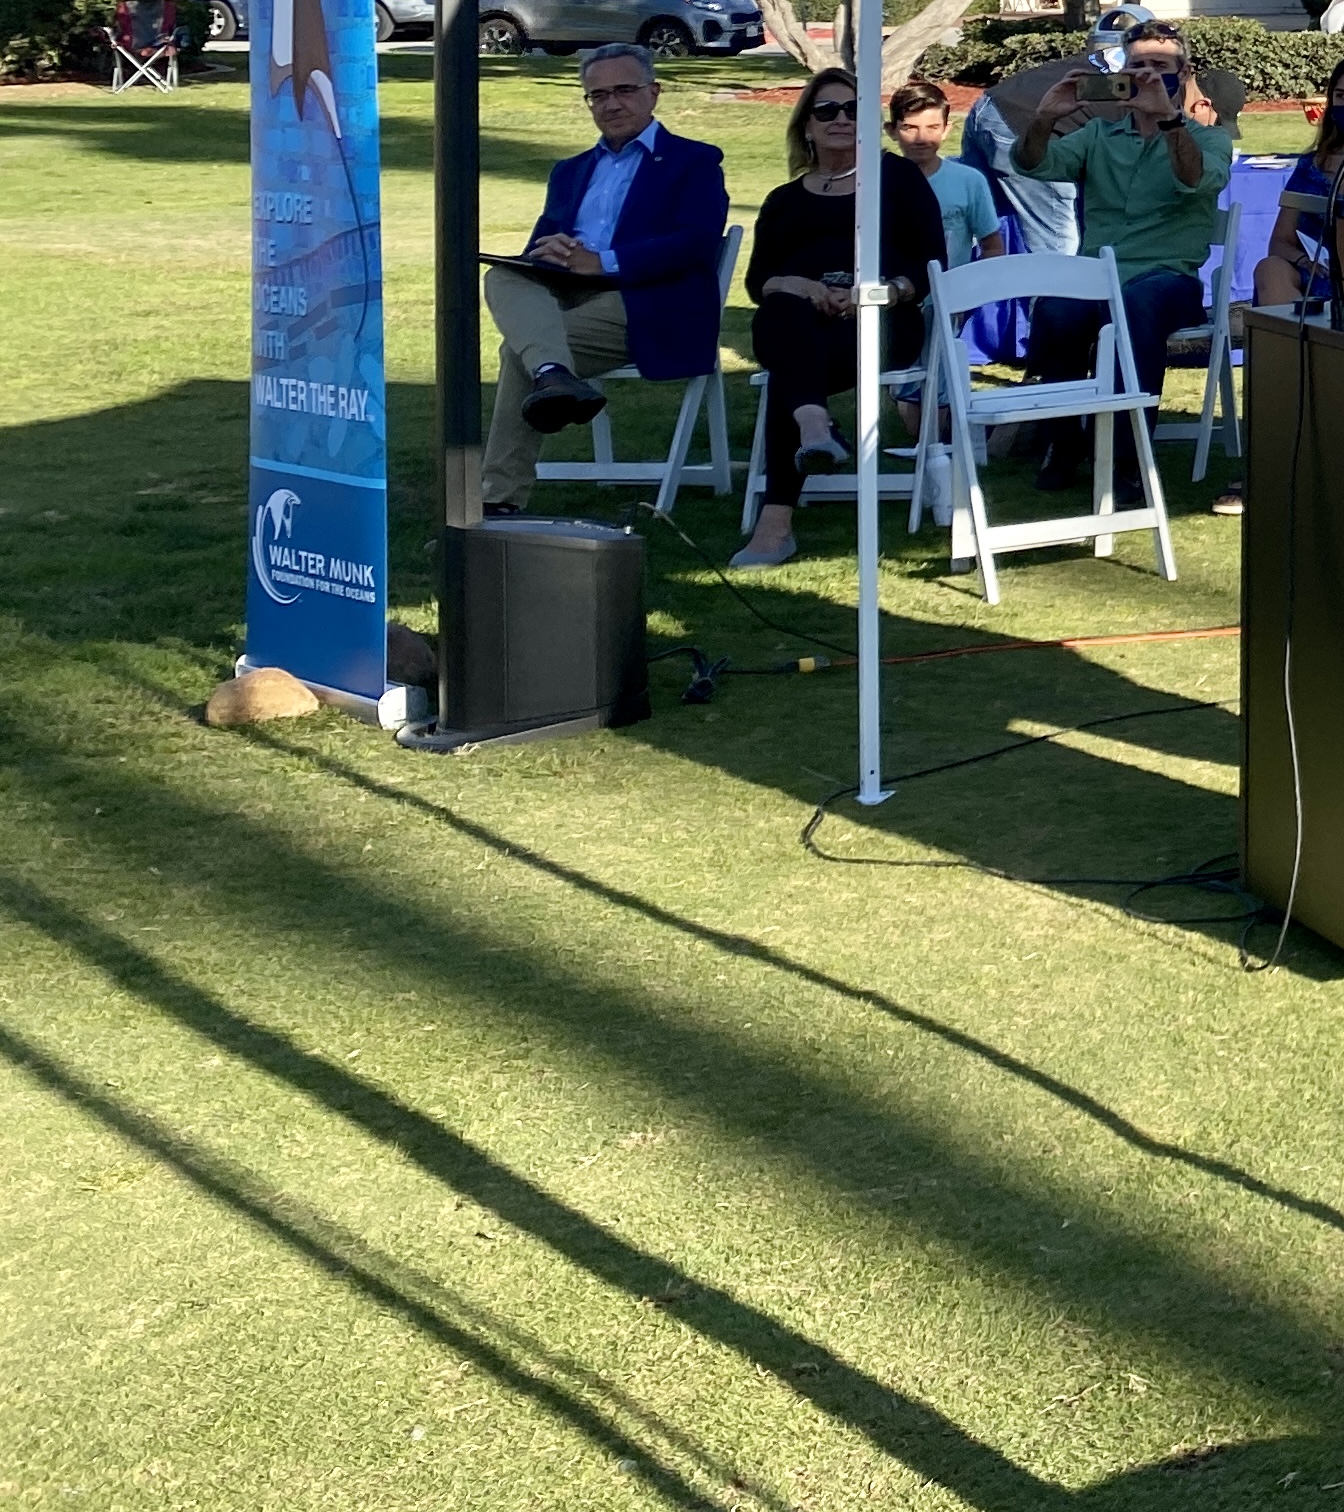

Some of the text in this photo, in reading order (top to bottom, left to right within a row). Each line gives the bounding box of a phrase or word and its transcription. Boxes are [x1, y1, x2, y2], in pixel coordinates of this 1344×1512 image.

[254, 374, 307, 412] WALTER
[309, 382, 336, 419] THE
[269, 544, 375, 588] WALTER MUNK
